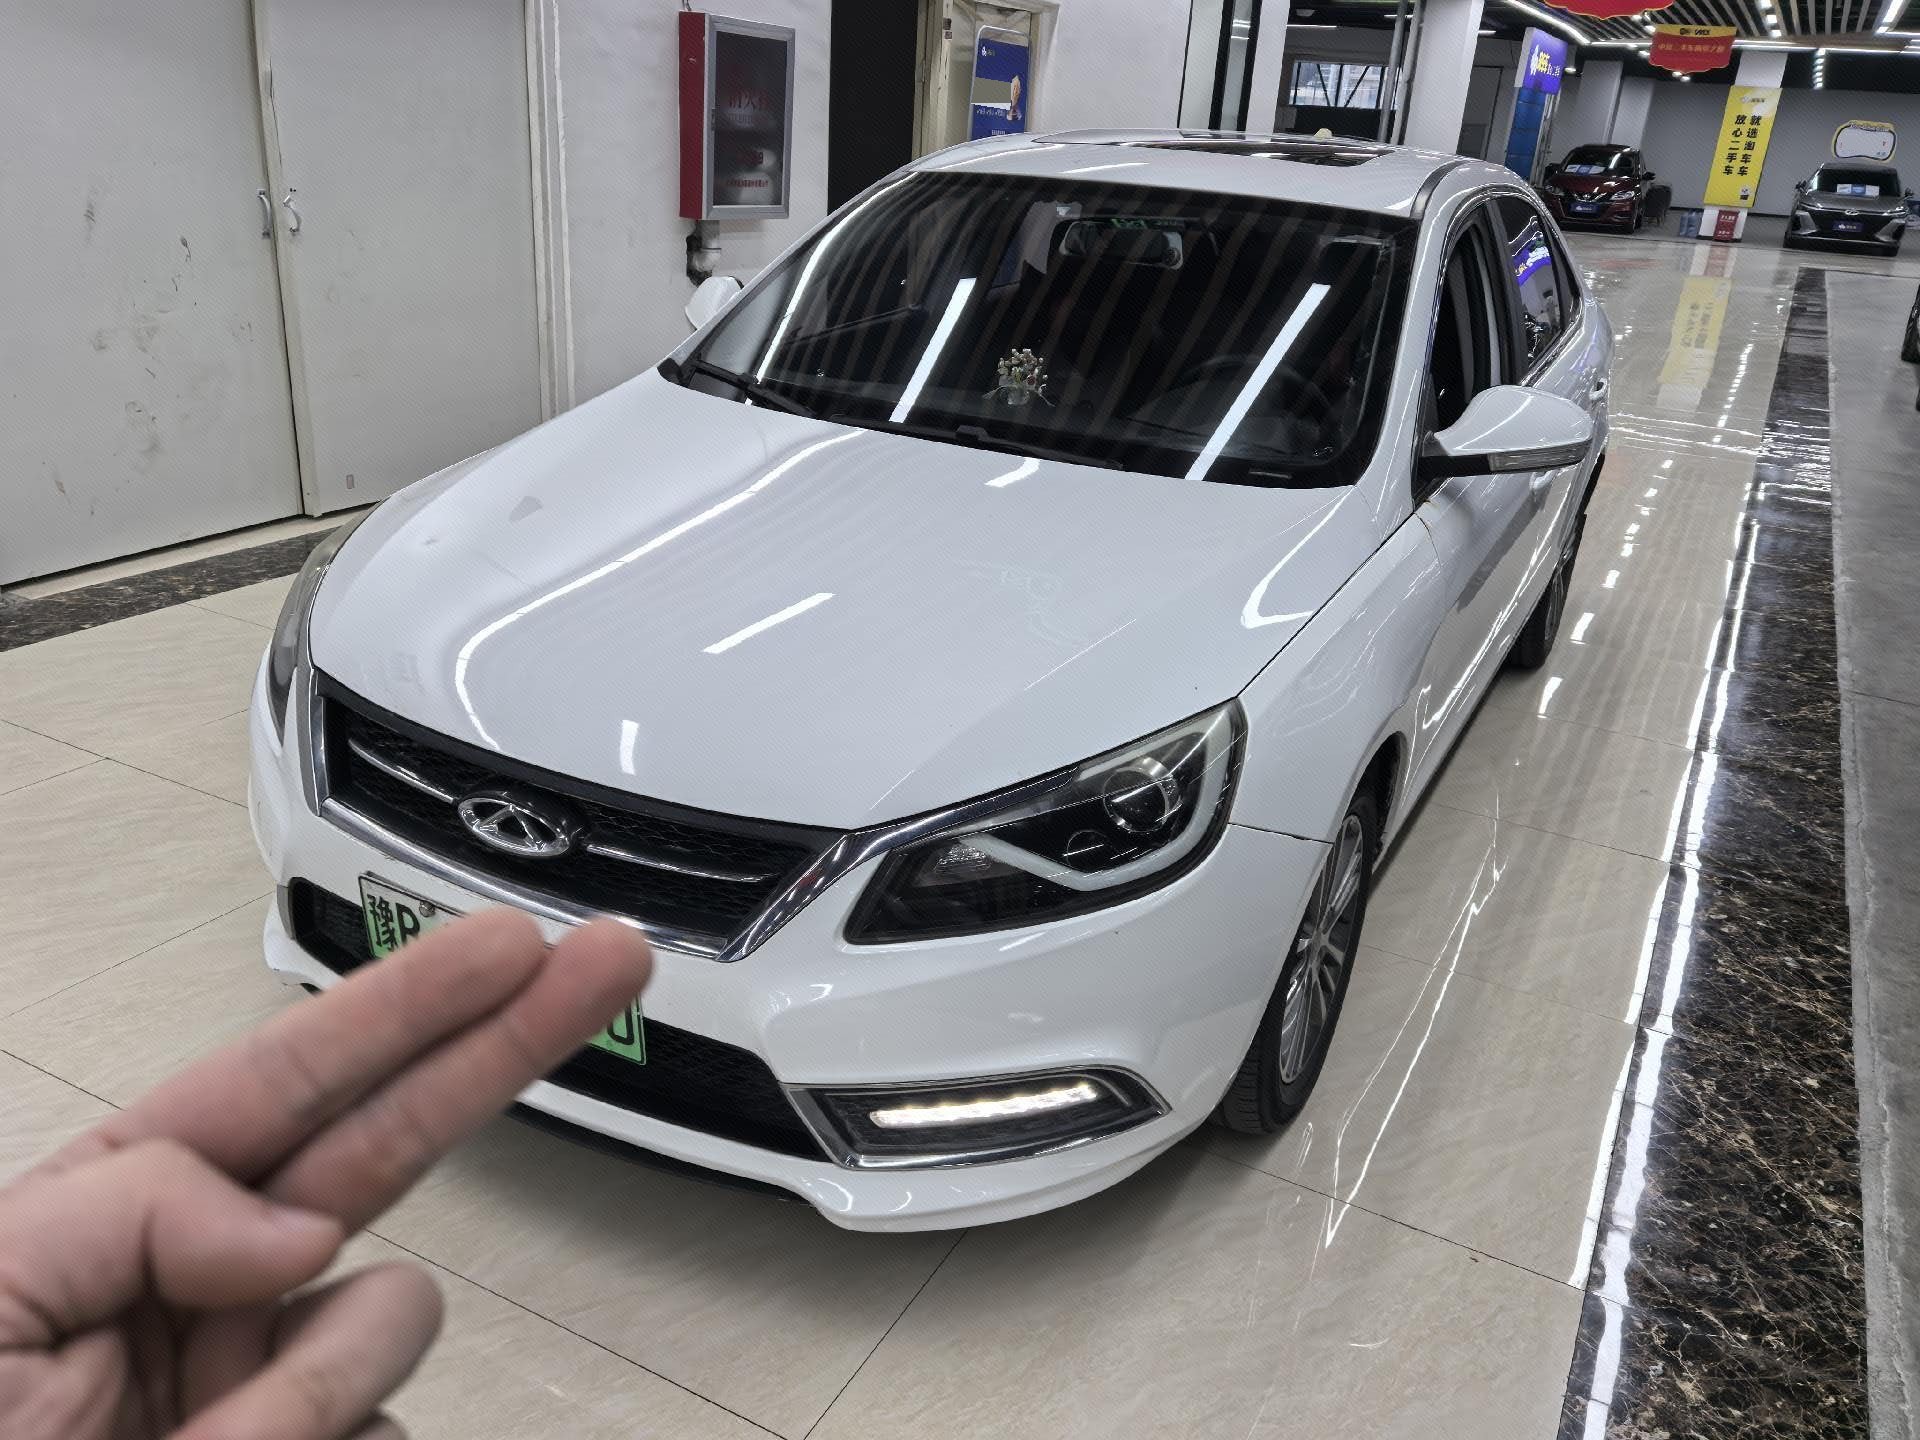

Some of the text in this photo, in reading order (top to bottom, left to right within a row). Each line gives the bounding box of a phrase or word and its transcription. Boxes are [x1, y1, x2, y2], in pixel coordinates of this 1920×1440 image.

[1722, 114, 1747, 176] 放心二手车
[1737, 114, 1763, 176] 就选淘车车
